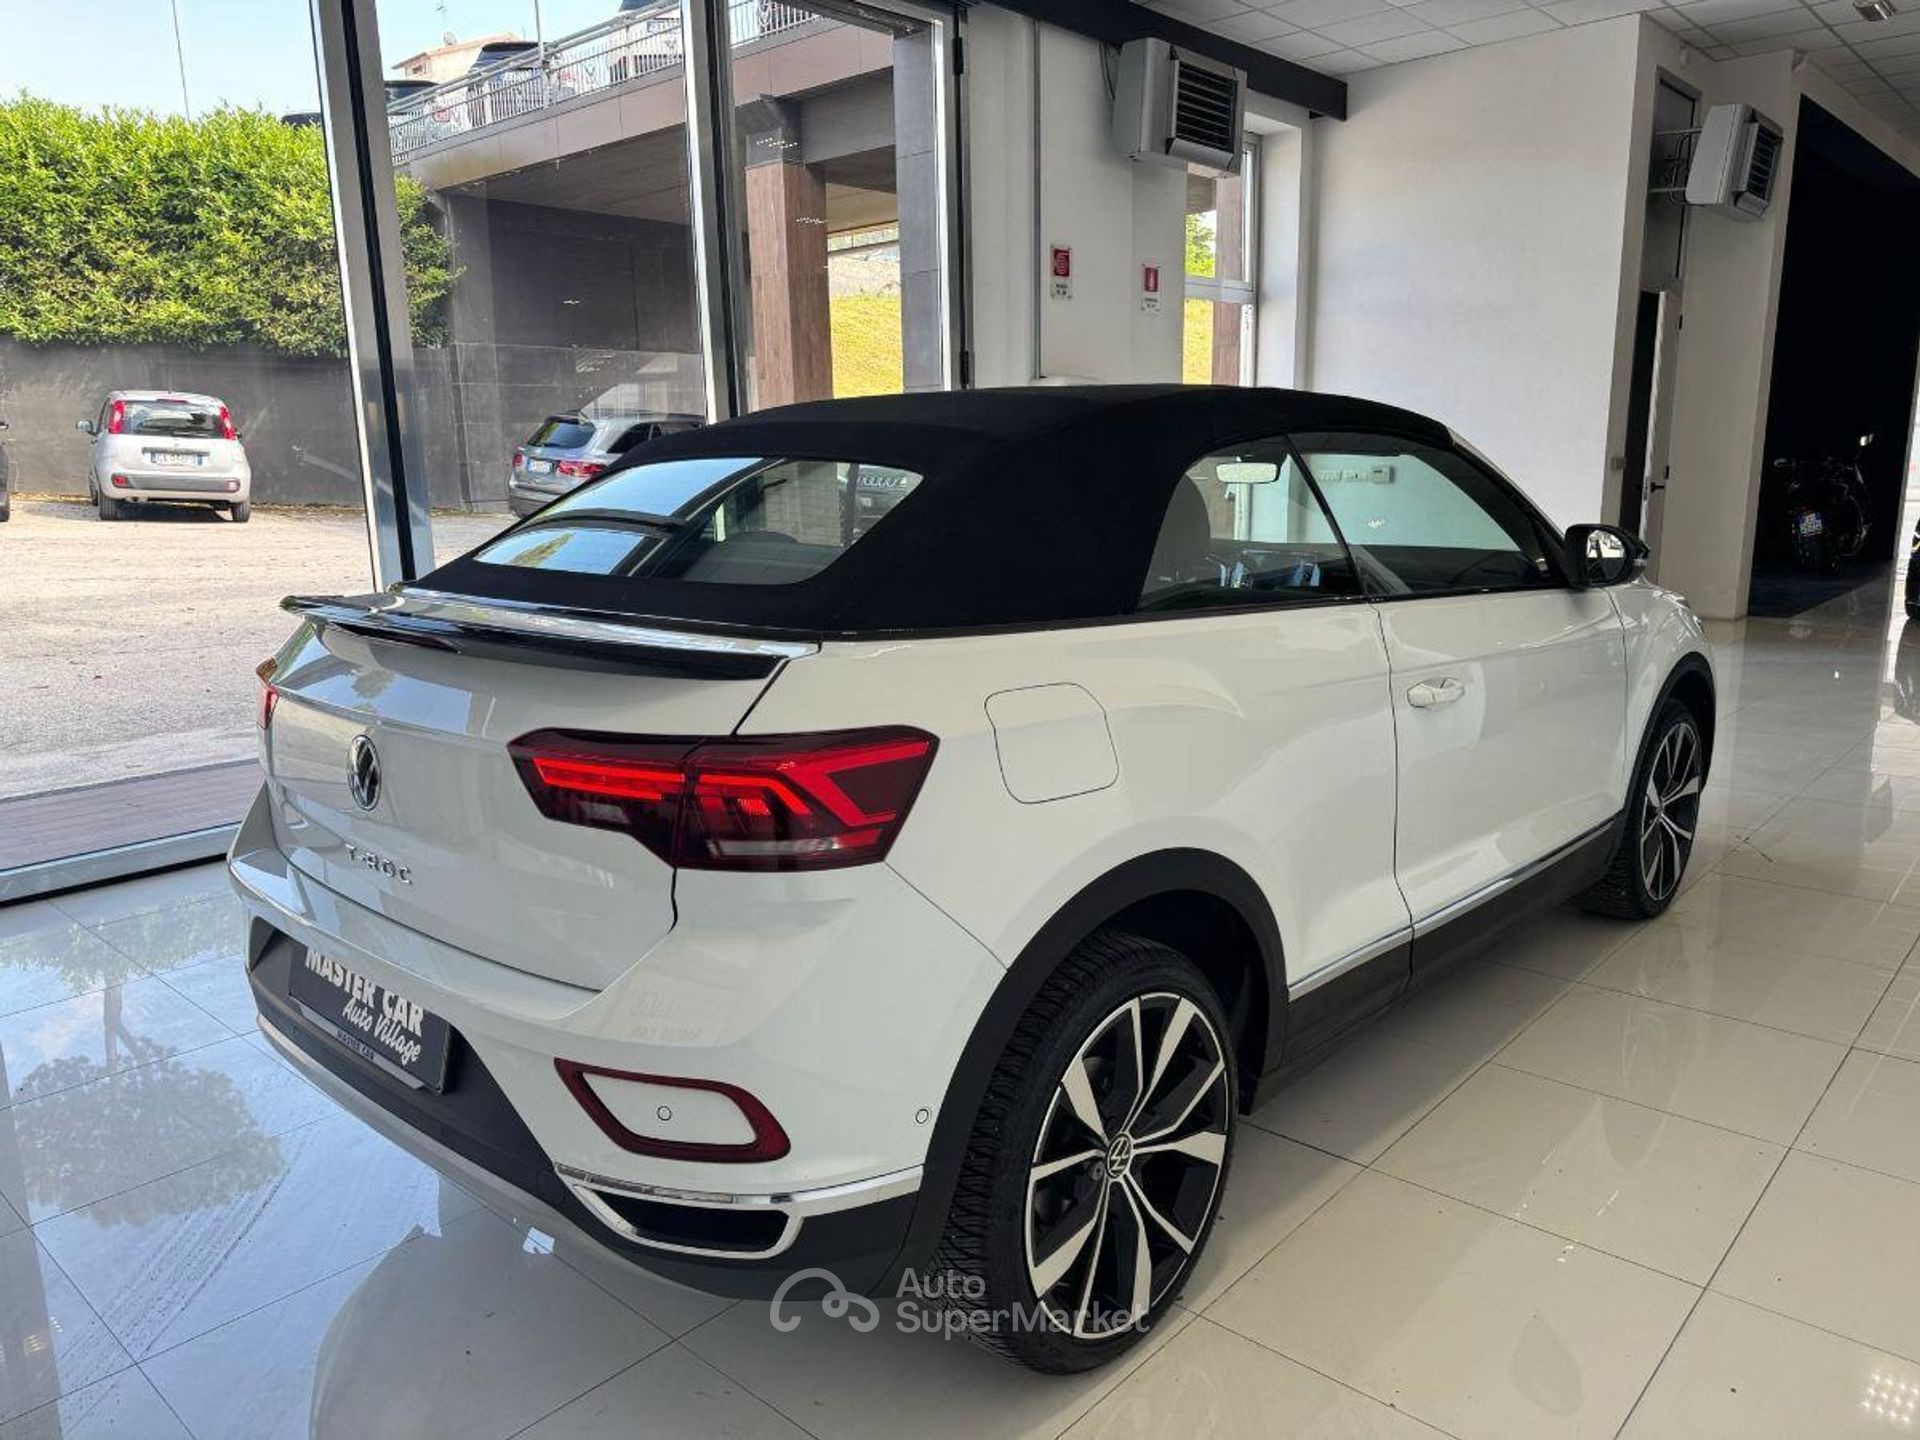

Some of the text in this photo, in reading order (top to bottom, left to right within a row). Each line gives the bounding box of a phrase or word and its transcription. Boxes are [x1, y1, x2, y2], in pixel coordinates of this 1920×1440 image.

[305, 948, 424, 1037] MASTER CAR
[342, 997, 421, 1065] Auto Village
